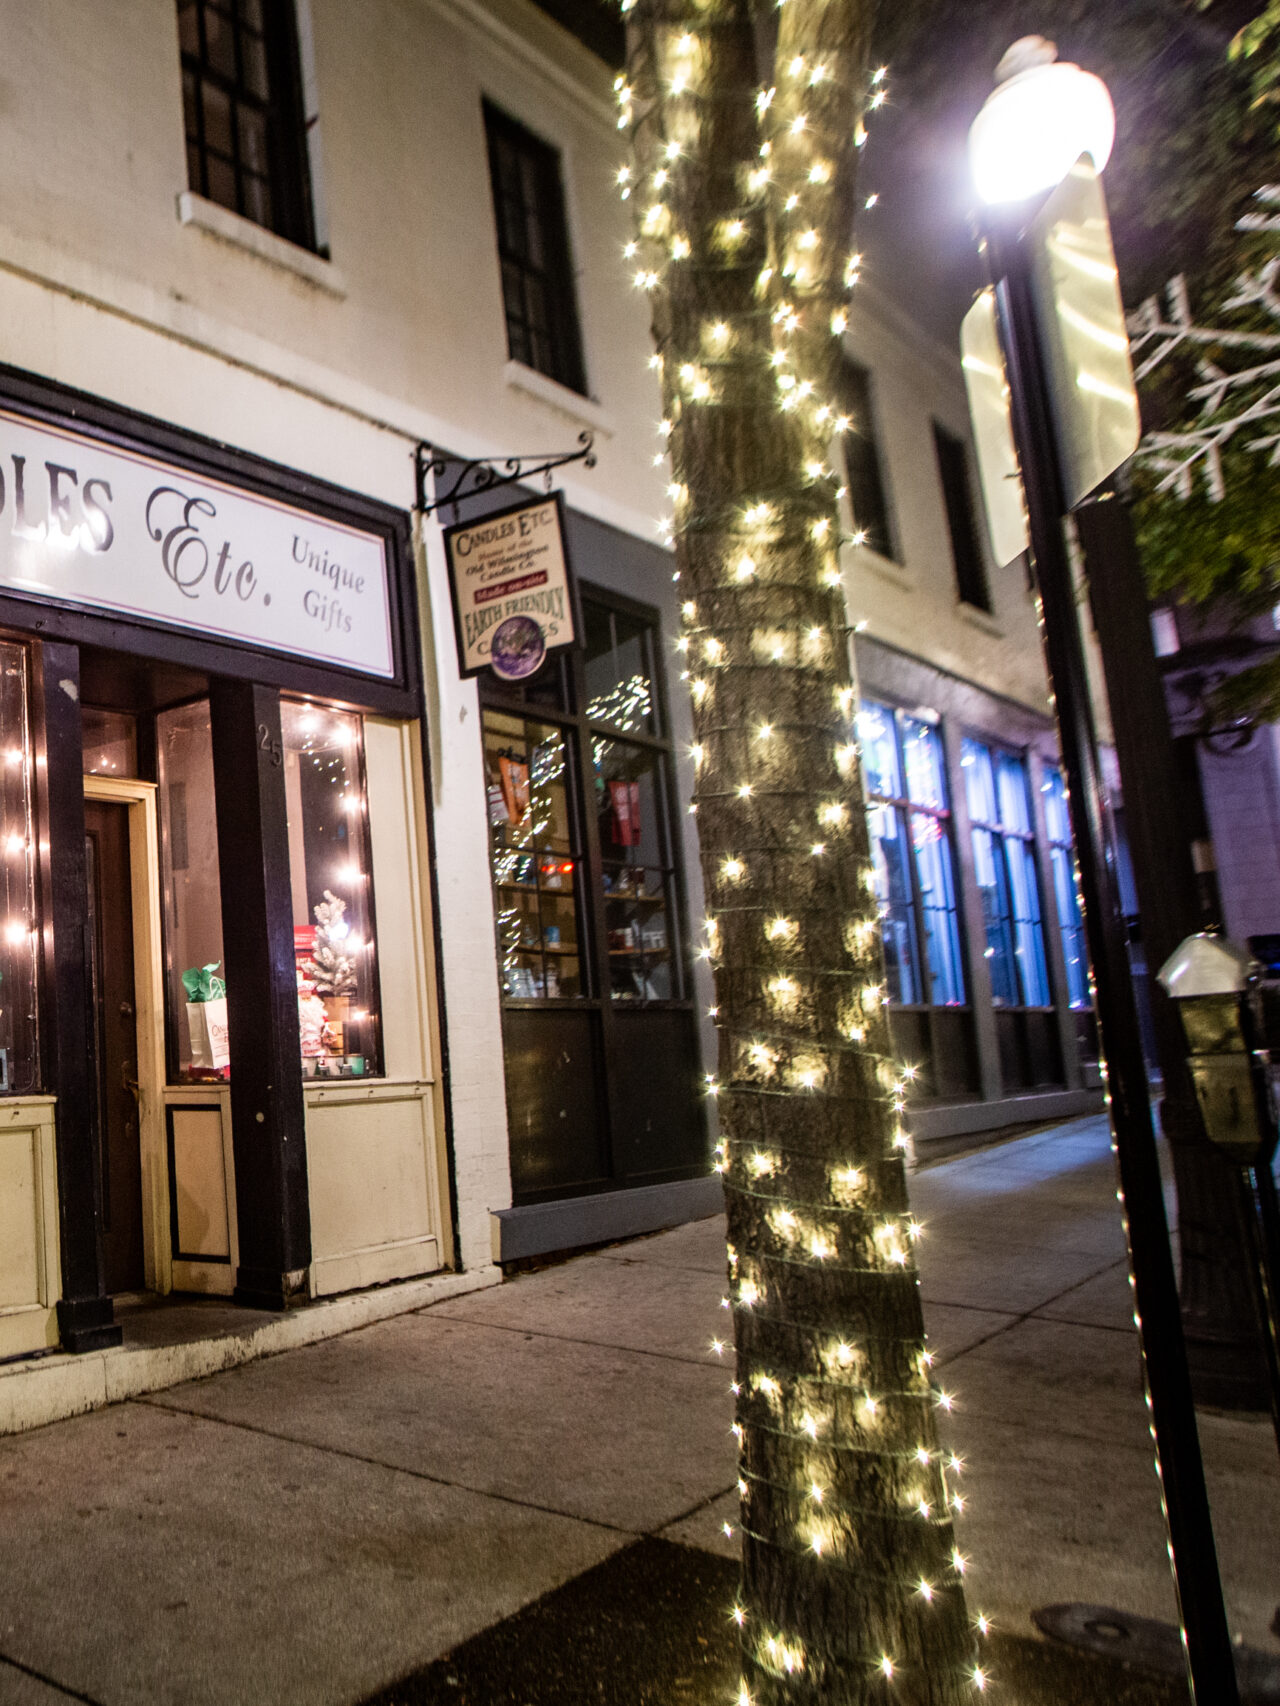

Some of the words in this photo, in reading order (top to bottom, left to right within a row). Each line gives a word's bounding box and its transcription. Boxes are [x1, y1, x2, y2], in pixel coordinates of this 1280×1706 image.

[146, 486, 271, 606] Etc.
[292, 535, 365, 594] Unique
[456, 520, 516, 557] CANDLES
[304, 590, 353, 633] Gifts
[464, 604, 502, 649] EARTH
[505, 586, 564, 619] FRIENDLY
[258, 723, 282, 768] 25
